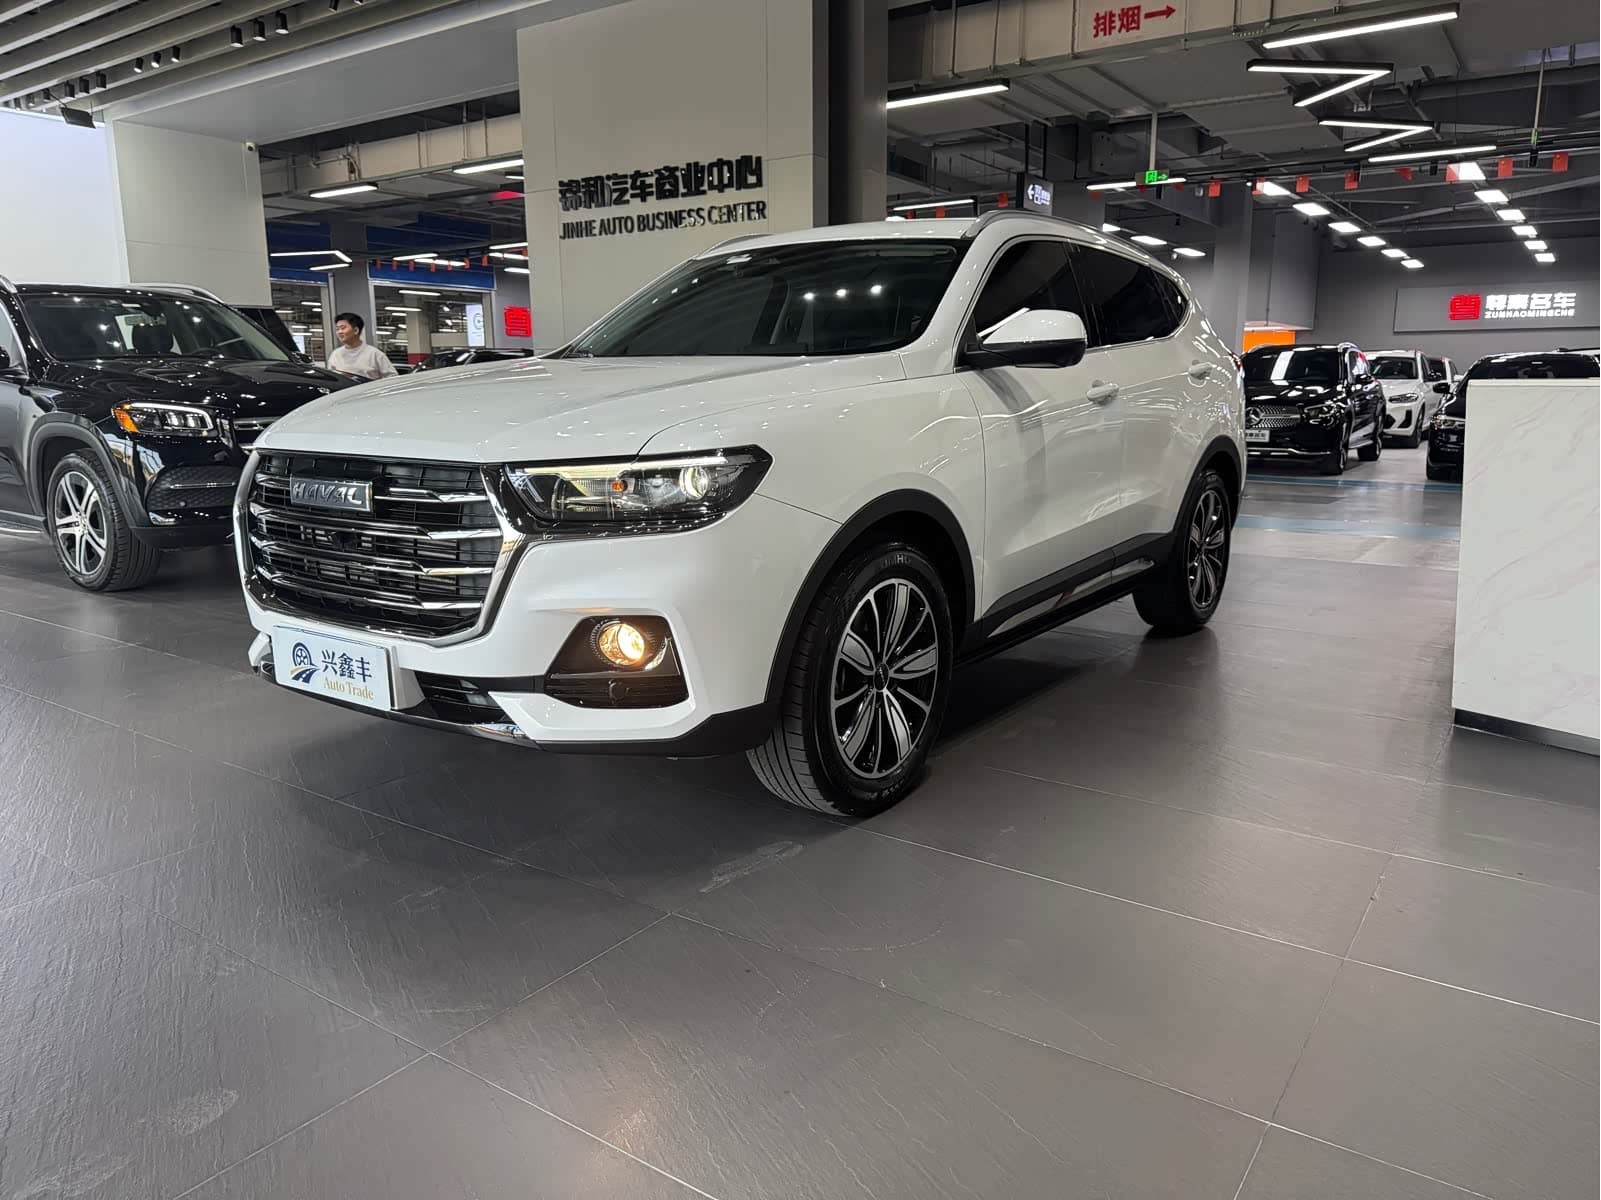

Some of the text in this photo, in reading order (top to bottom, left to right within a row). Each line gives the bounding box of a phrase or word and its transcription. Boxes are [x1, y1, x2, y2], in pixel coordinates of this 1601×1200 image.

[1093, 5, 1141, 38] 排烟
[558, 155, 763, 211] 锦和汽车商业中心
[559, 200, 767, 240] JINHE AUTO BUSINESS CENTER
[292, 482, 363, 505] HAVAL
[321, 649, 373, 683] 兴鑫丰
[323, 676, 374, 701] Auto Trade
